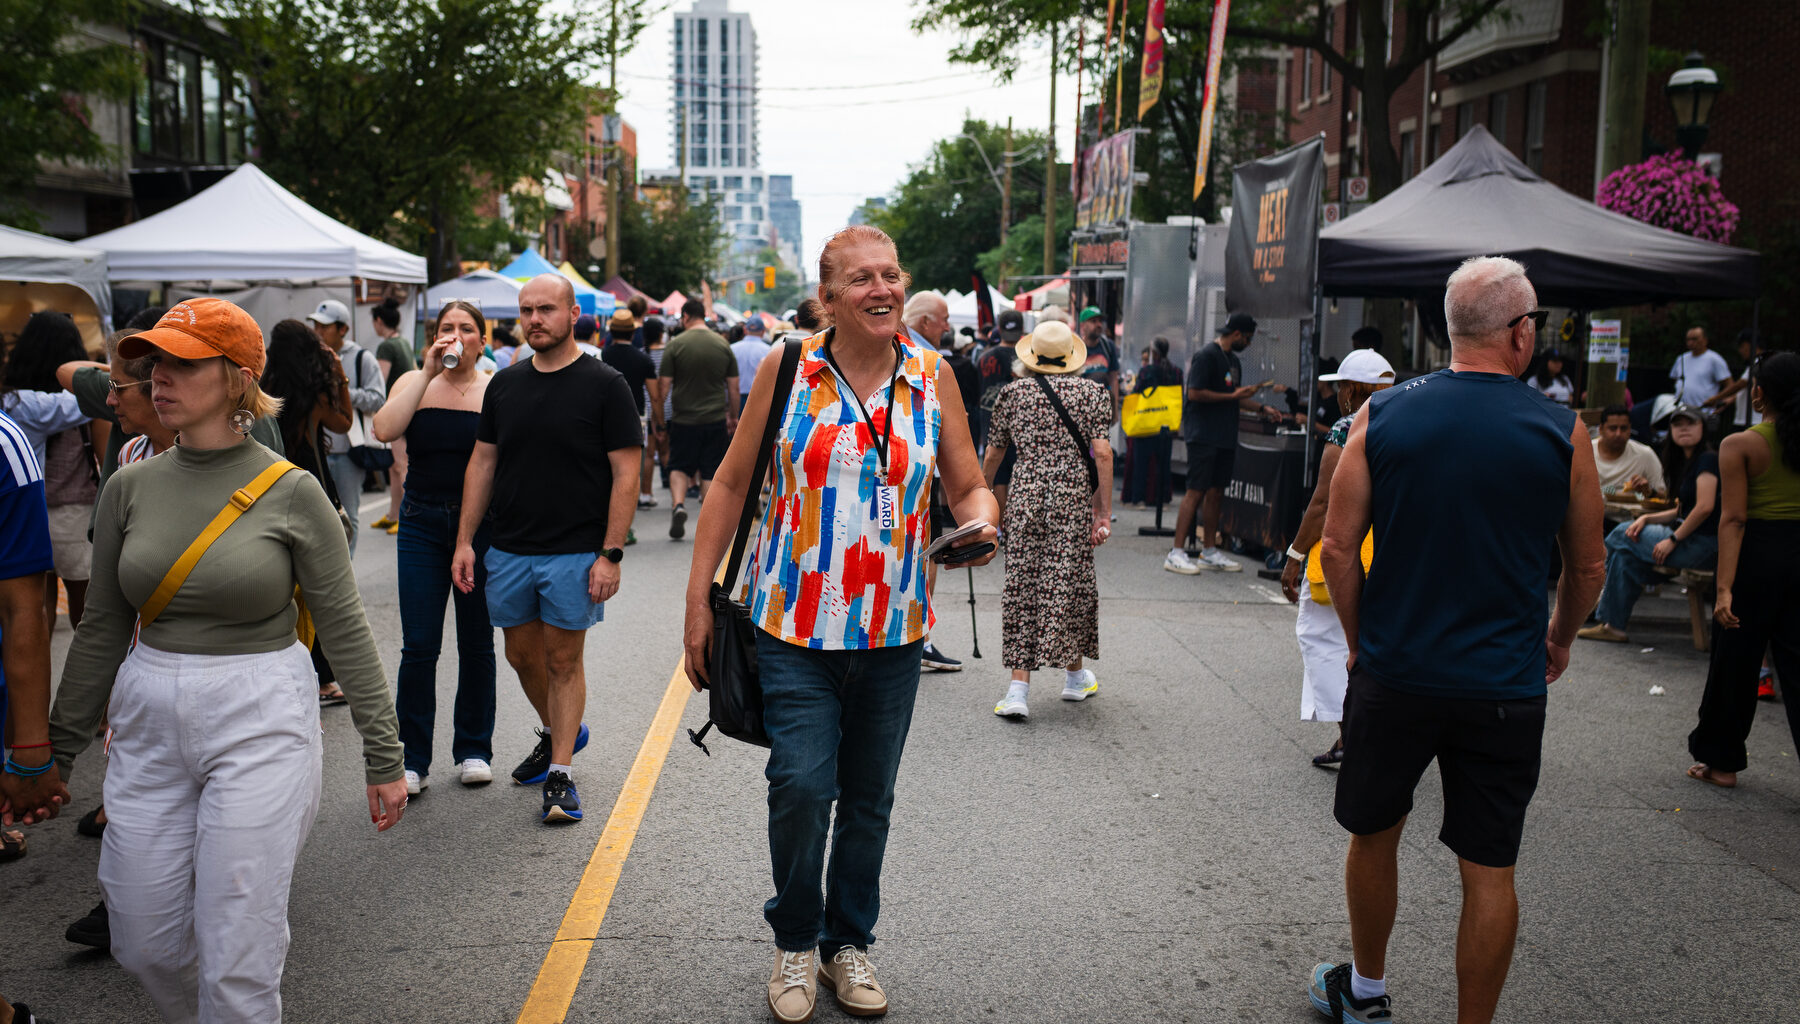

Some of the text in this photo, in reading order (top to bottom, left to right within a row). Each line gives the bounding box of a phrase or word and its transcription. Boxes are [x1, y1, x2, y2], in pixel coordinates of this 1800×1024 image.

[1256, 187, 1288, 243] MEAT
[880, 487, 892, 528] WARD
[1244, 483, 1264, 505] AGAIN
